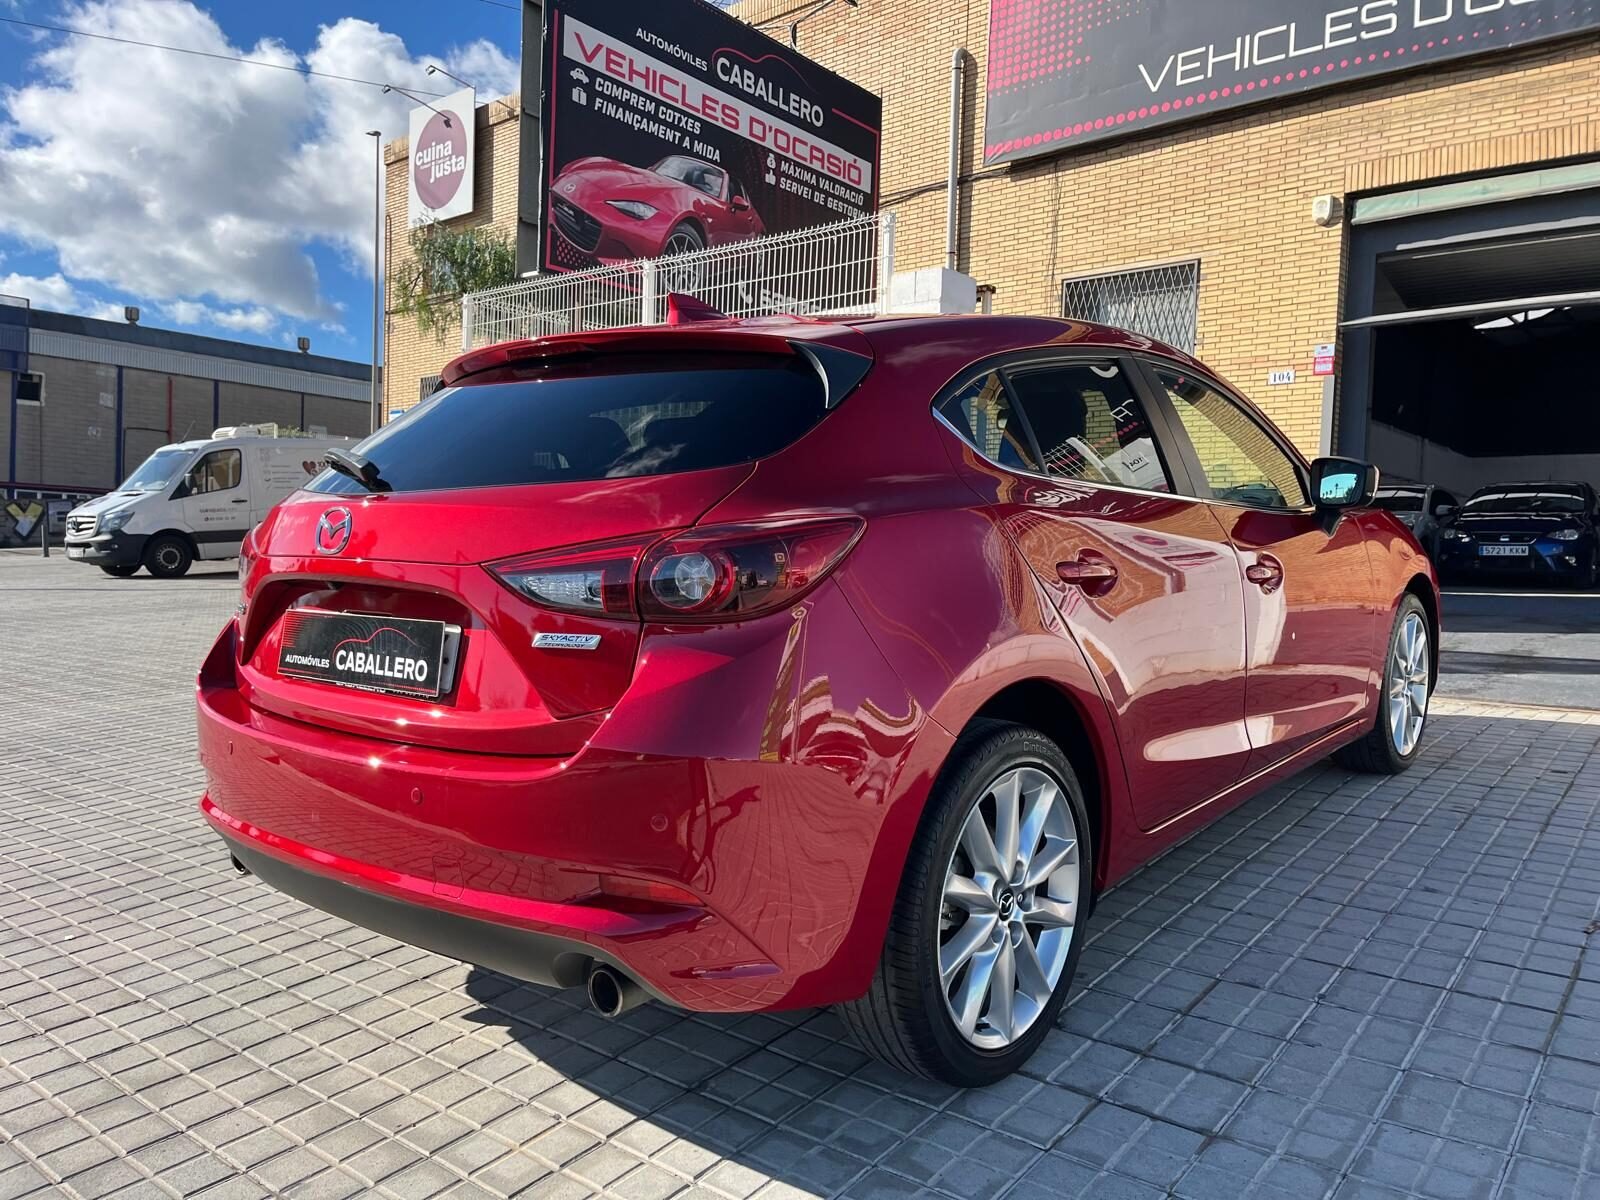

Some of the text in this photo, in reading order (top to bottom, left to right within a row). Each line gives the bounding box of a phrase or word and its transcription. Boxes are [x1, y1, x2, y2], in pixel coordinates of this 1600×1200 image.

[1138, 0, 1398, 93] VEHICLES
[636, 27, 824, 128] AUTOMÓVILES CABALLERO
[573, 31, 862, 186] VEHICLES D'OCASIÓ
[594, 77, 702, 135] COMPREM COTXES
[594, 97, 721, 163] FINANÇAMENT A MIDA
[415, 140, 452, 166] cuina
[429, 154, 465, 184] justa
[779, 178, 812, 200] SERVEI
[813, 191, 826, 206] DE
[780, 160, 864, 206] MÀXIMA VALORACIÓ
[1273, 372, 1291, 383] 104
[1485, 546, 1506, 554] 5721
[540, 634, 594, 642] SKYACTIV
[285, 649, 429, 682] AUTOMÓVILES CABALLERO
